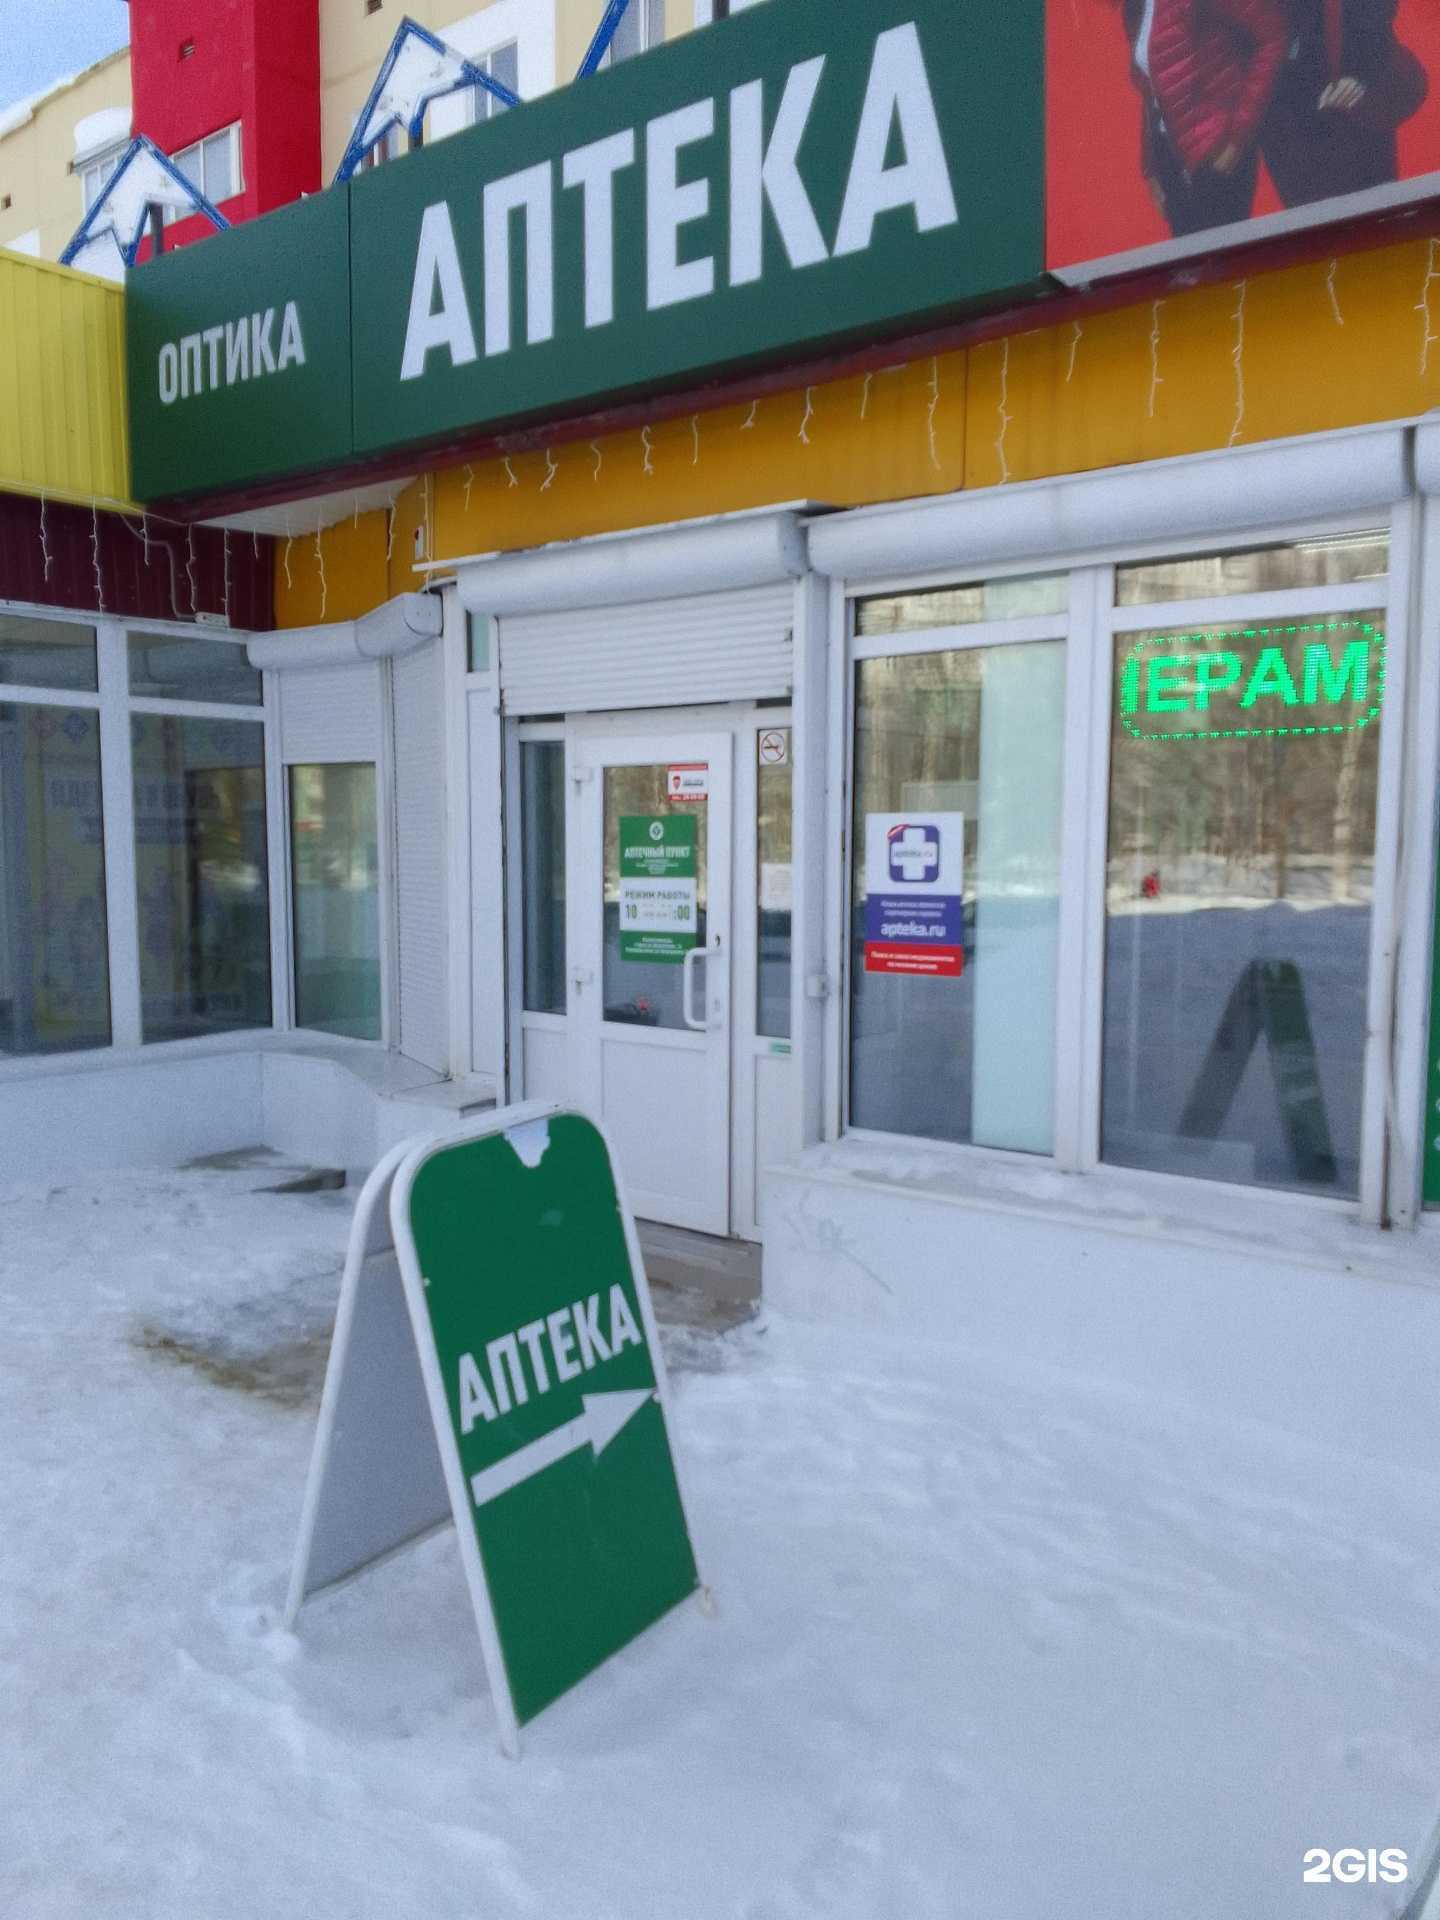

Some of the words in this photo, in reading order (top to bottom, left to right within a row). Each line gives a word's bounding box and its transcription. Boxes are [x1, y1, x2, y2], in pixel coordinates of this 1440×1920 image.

[400, 21, 958, 381] АПТЕКА
[158, 301, 306, 405] ОПТИКА
[625, 890, 655, 900] РЕЖИМ
[657, 890, 691, 900] РАБОТЫ
[880, 920, 946, 938] apteka.ru
[460, 1283, 642, 1435] АПТЕКА
